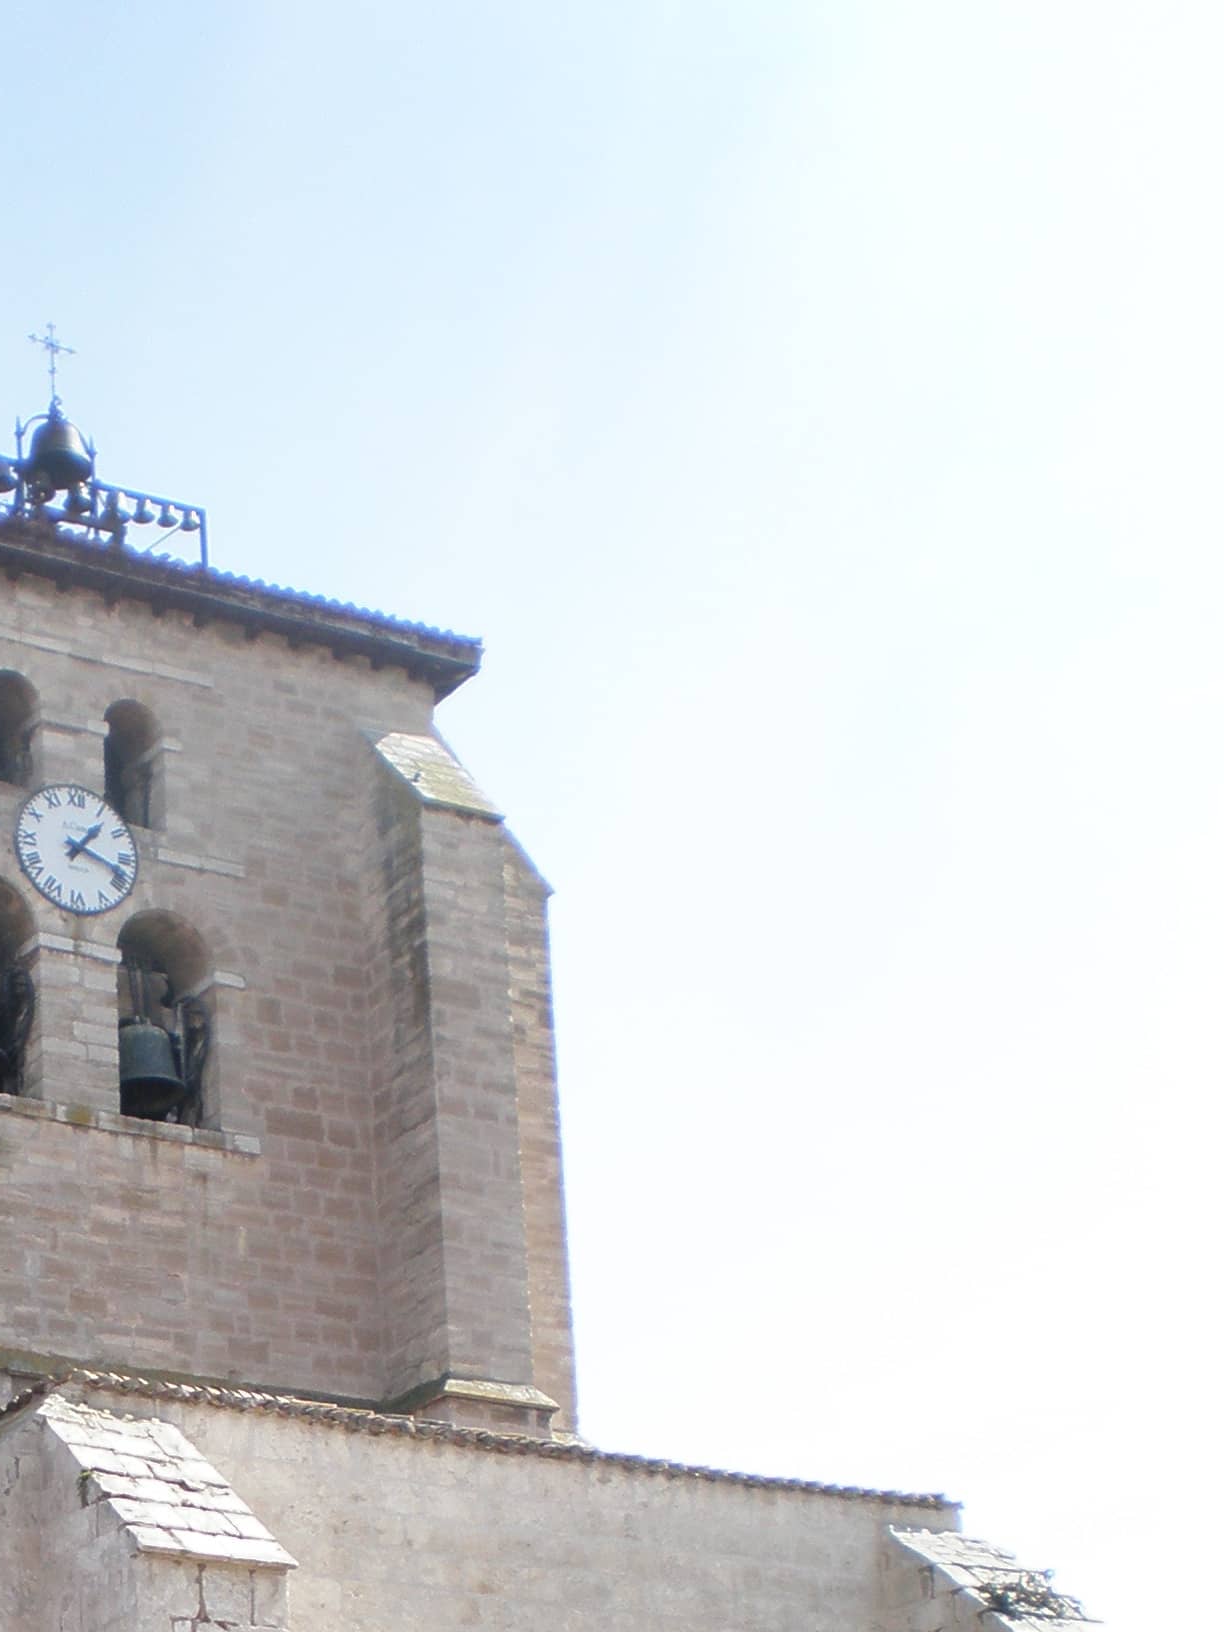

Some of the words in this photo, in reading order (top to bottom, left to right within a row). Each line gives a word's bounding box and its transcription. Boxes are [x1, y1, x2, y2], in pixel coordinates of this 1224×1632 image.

[44, 789, 62, 808] XI
[67, 790, 85, 808] XII
[28, 808, 43, 822] X
[96, 804, 105, 818] I
[23, 829, 37, 846] IX
[111, 828, 125, 839] II
[25, 851, 44, 876] VIII
[118, 852, 132, 865] III
[44, 875, 62, 897] VII
[71, 889, 85, 907] VI
[98, 889, 109, 904] V
